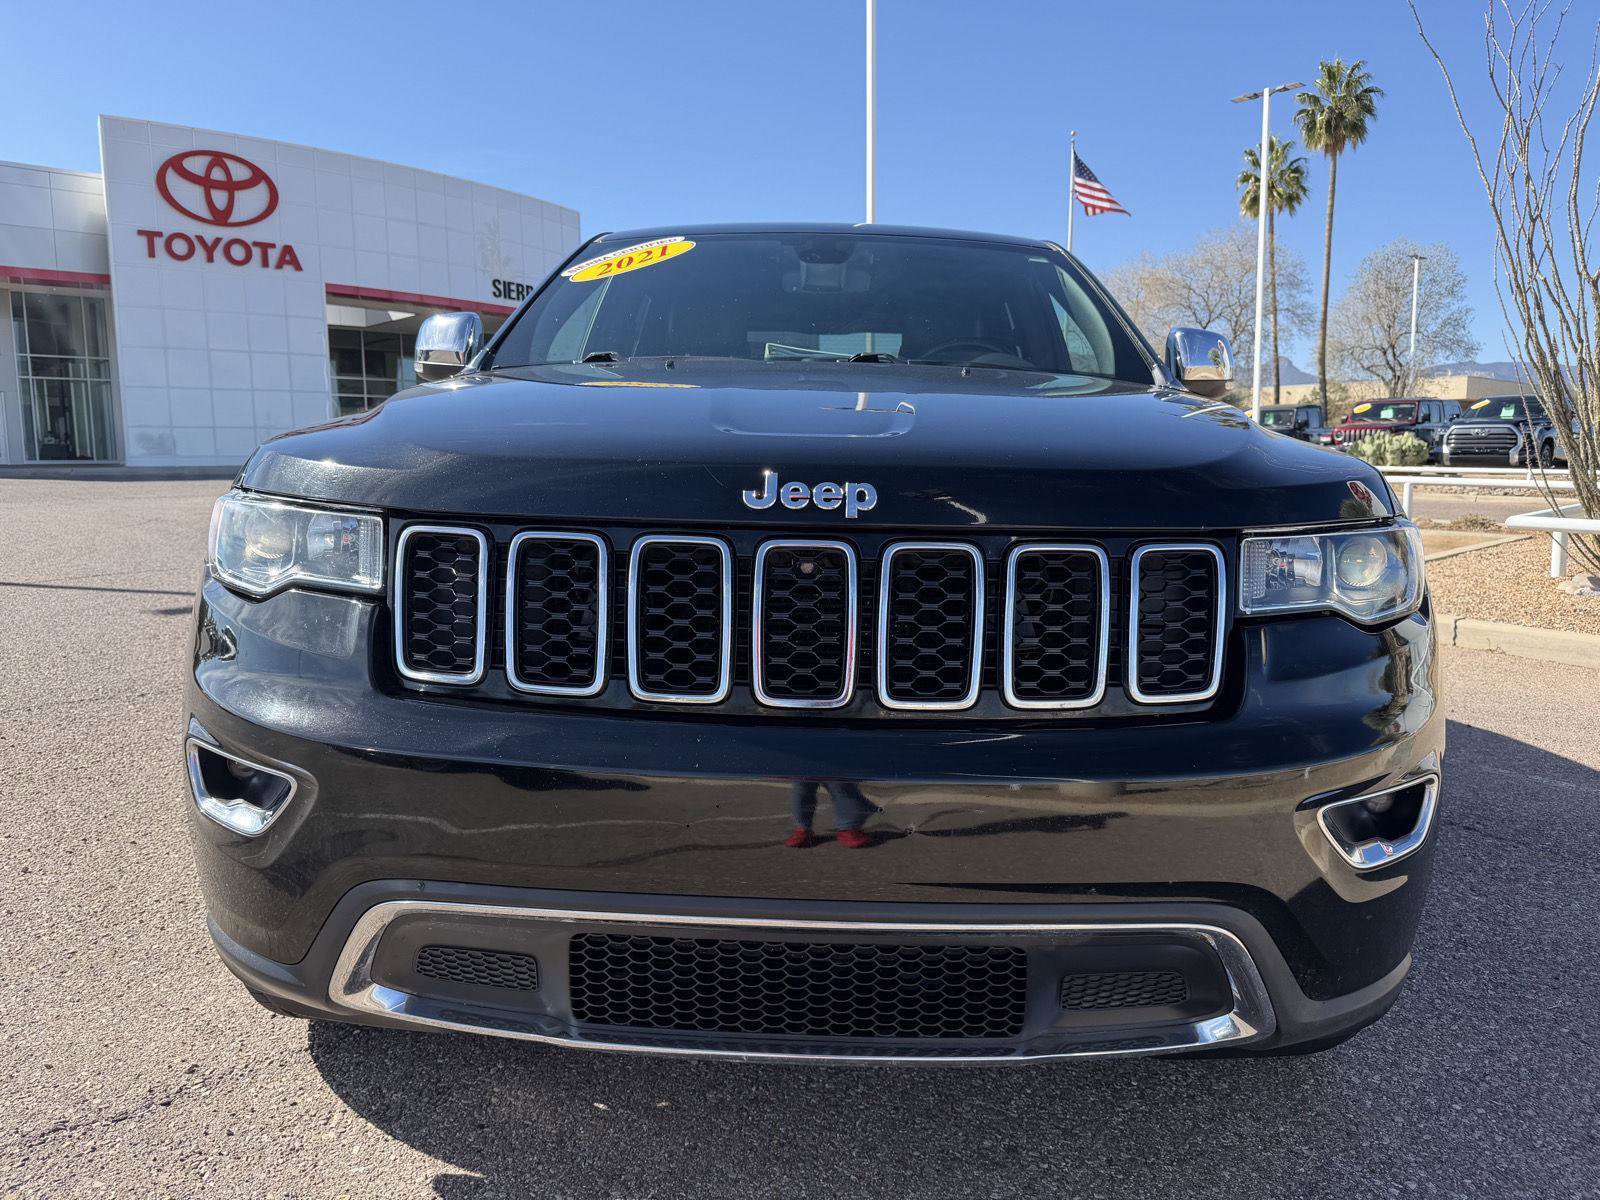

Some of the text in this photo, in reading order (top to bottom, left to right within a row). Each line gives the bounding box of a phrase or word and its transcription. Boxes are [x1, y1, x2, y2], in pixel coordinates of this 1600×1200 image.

[137, 229, 303, 272] TOYOTA
[567, 238, 678, 274] SIERRA CERTIFIED
[597, 245, 667, 277] 2021
[742, 471, 877, 518] Jeep
